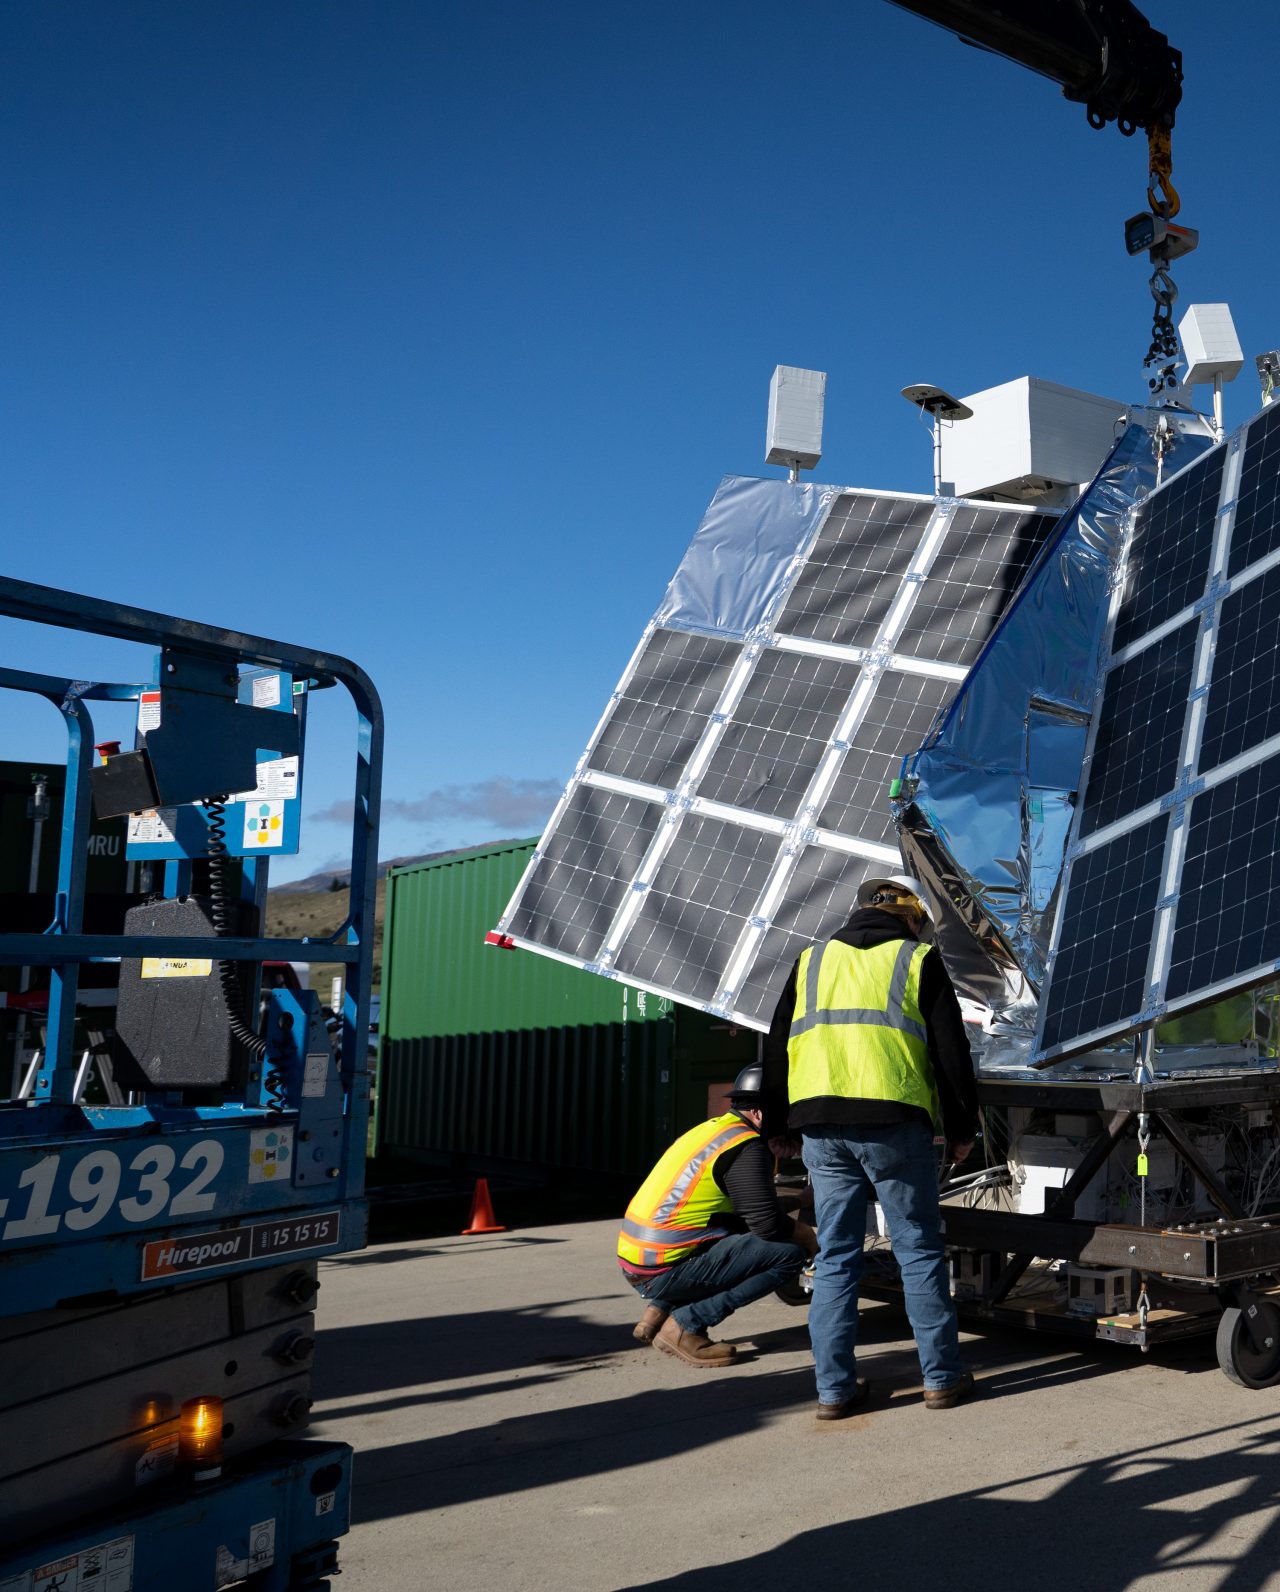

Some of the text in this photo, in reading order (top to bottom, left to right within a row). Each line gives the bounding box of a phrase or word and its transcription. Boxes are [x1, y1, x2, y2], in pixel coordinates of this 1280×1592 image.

[273, 1227, 290, 1246] 15
[294, 1224, 311, 1242] 15
[314, 1220, 330, 1239] 15
[156, 1236, 242, 1268] Hirepool
